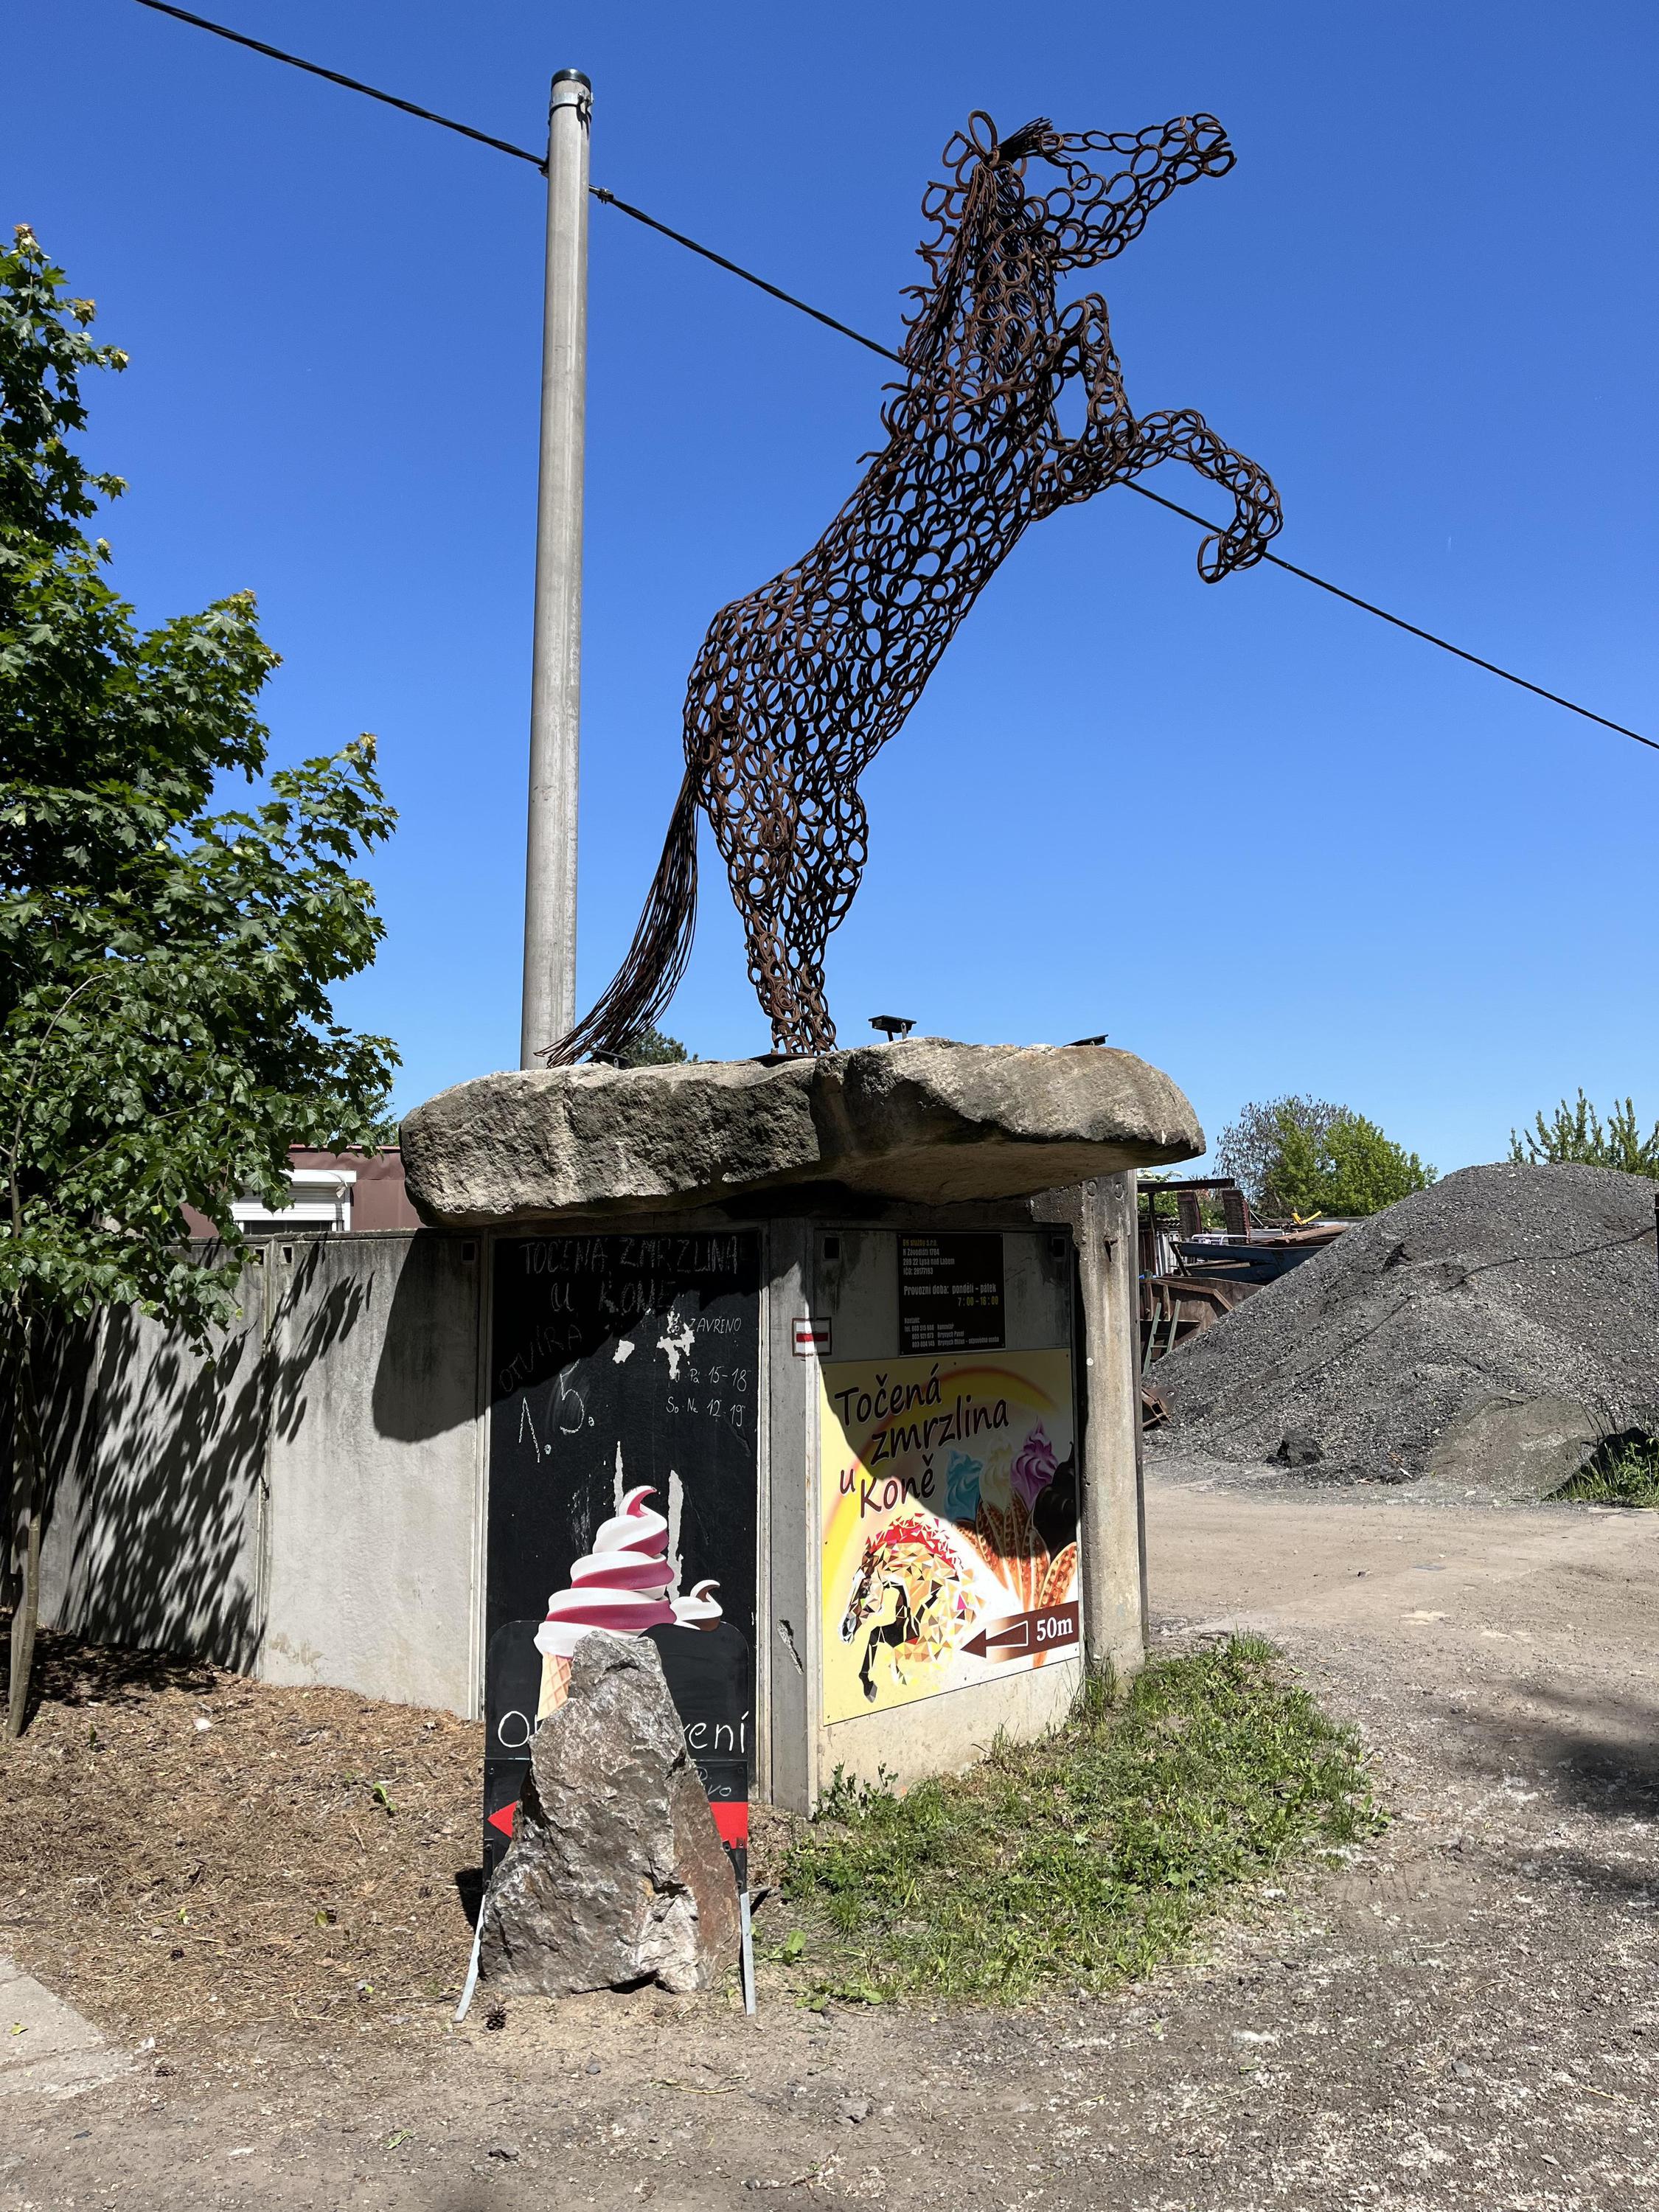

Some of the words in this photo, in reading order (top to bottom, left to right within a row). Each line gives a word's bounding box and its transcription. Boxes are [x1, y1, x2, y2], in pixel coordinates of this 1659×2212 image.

[940, 1257, 956, 1265] Labem
[932, 1284, 949, 1295] doba:
[980, 1283, 996, 1294] pátek
[835, 1363, 942, 1426] Točená
[870, 1394, 1009, 1465] zmrzlina
[839, 1468, 856, 1495] u
[860, 1453, 936, 1519] Koně
[1036, 1616, 1074, 1642] 50m
